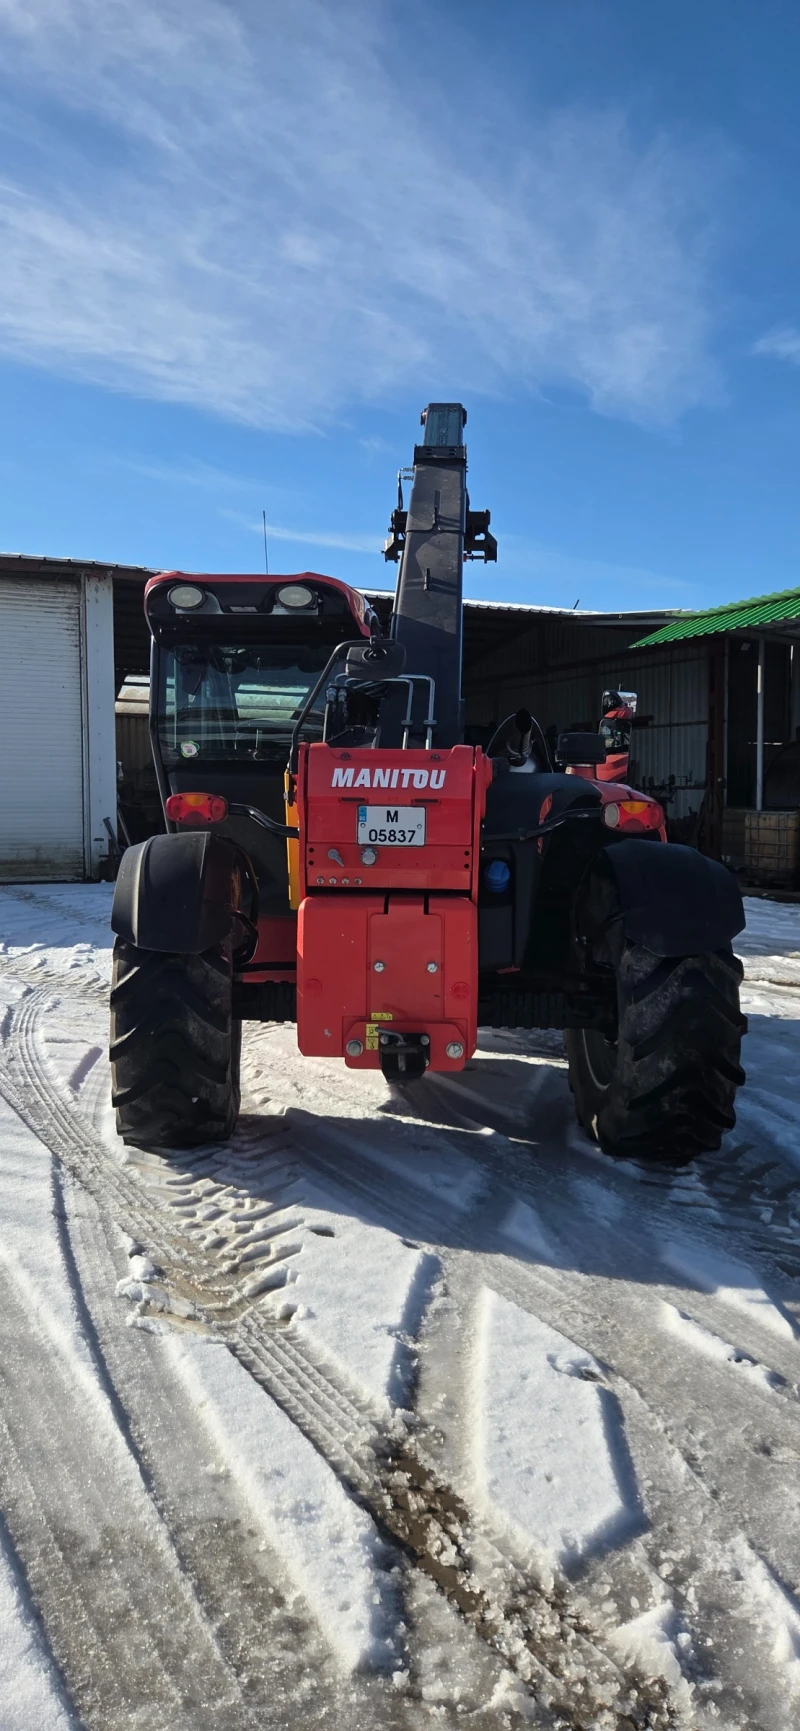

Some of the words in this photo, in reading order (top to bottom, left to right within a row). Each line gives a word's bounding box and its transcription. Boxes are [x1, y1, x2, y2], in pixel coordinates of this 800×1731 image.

[331, 768, 446, 789] MANITOU
[386, 810, 399, 823] M
[368, 829, 416, 843] 05837
